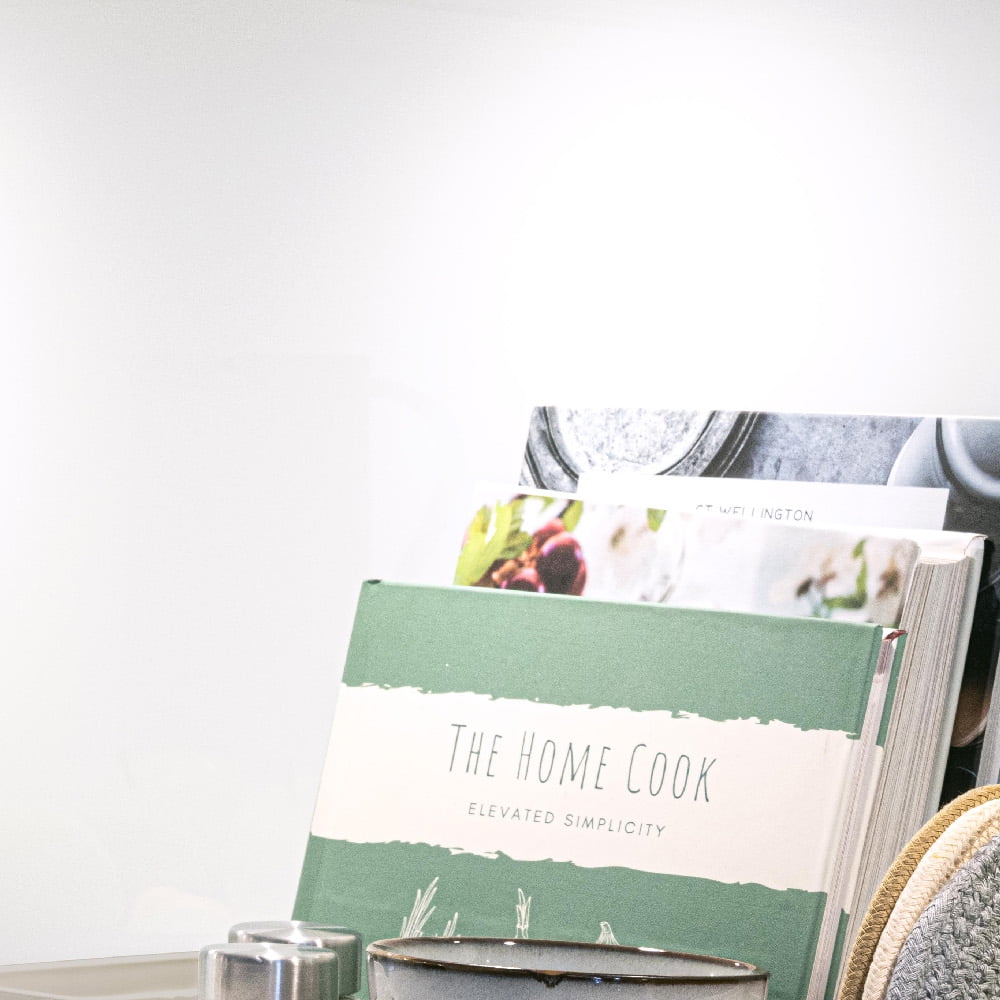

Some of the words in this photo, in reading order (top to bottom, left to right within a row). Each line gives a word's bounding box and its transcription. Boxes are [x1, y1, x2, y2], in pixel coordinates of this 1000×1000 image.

[449, 723, 503, 777] THE
[516, 731, 611, 790] HOME
[627, 743, 717, 802] COOK
[468, 802, 555, 824] ELEVATED
[563, 813, 666, 837] SIMPLICITY
